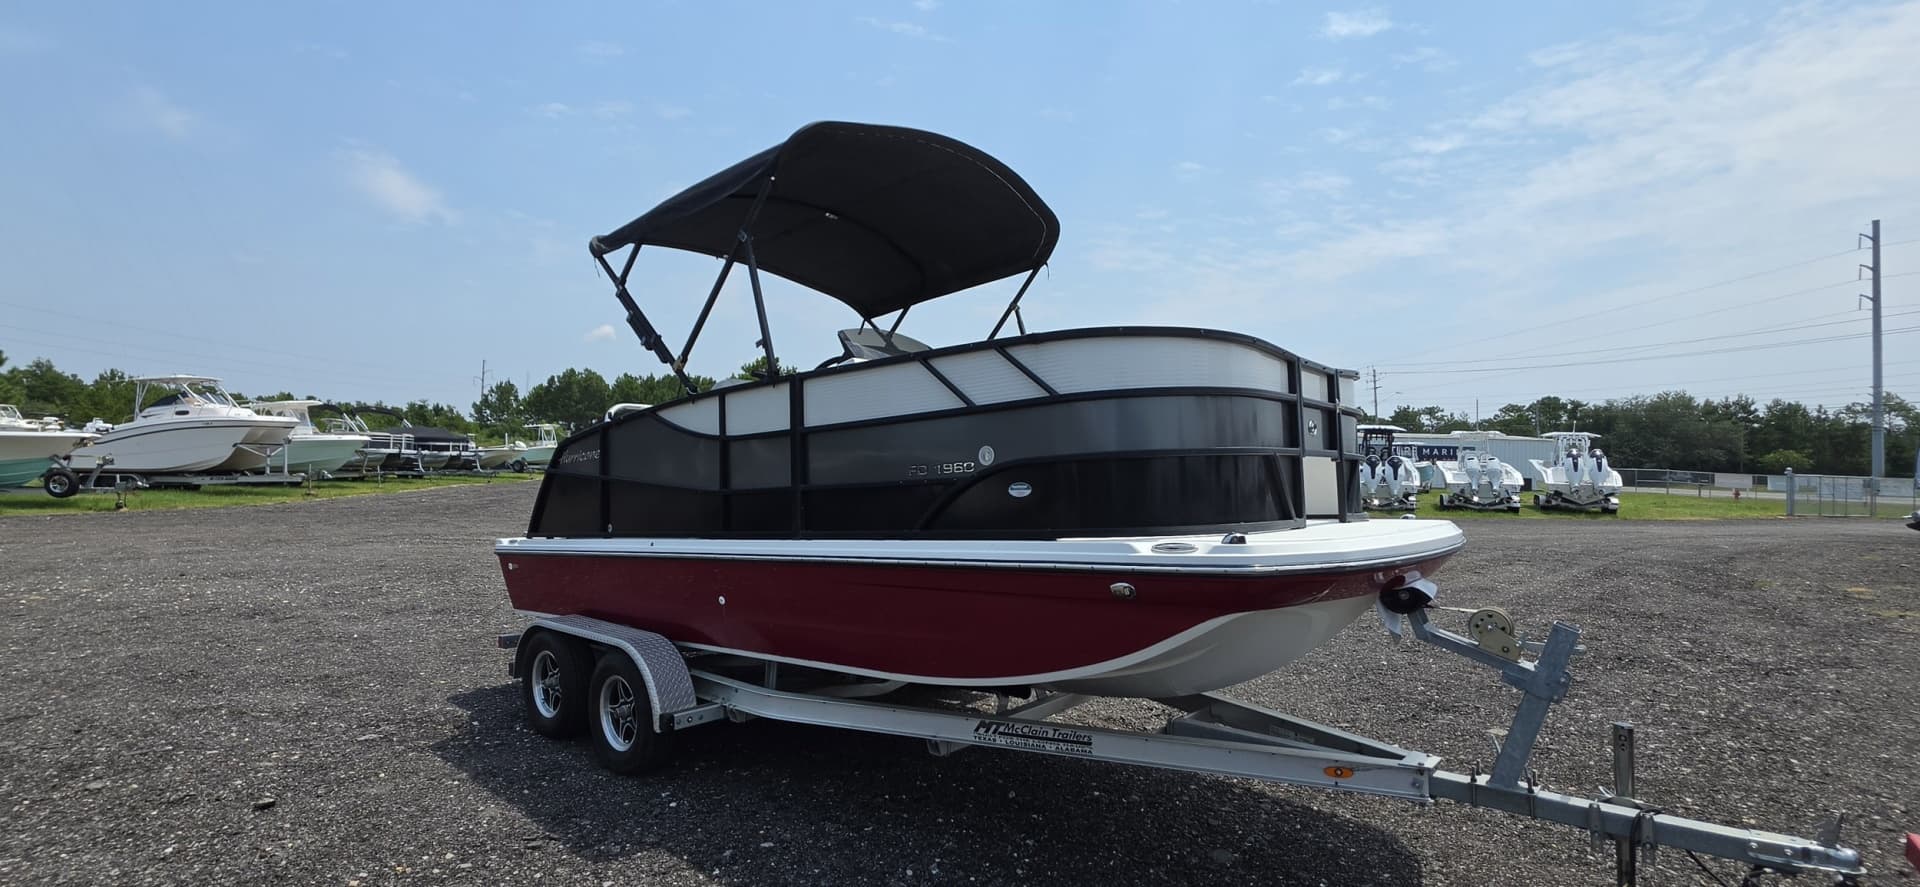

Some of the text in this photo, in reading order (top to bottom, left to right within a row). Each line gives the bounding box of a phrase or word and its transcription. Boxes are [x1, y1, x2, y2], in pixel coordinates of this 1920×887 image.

[1422, 447, 1459, 456] MARI
[1003, 723, 1093, 741] McClain Trailers
[1005, 740, 1047, 750] LOUISIANA
[1055, 745, 1093, 754] ALABAMA
